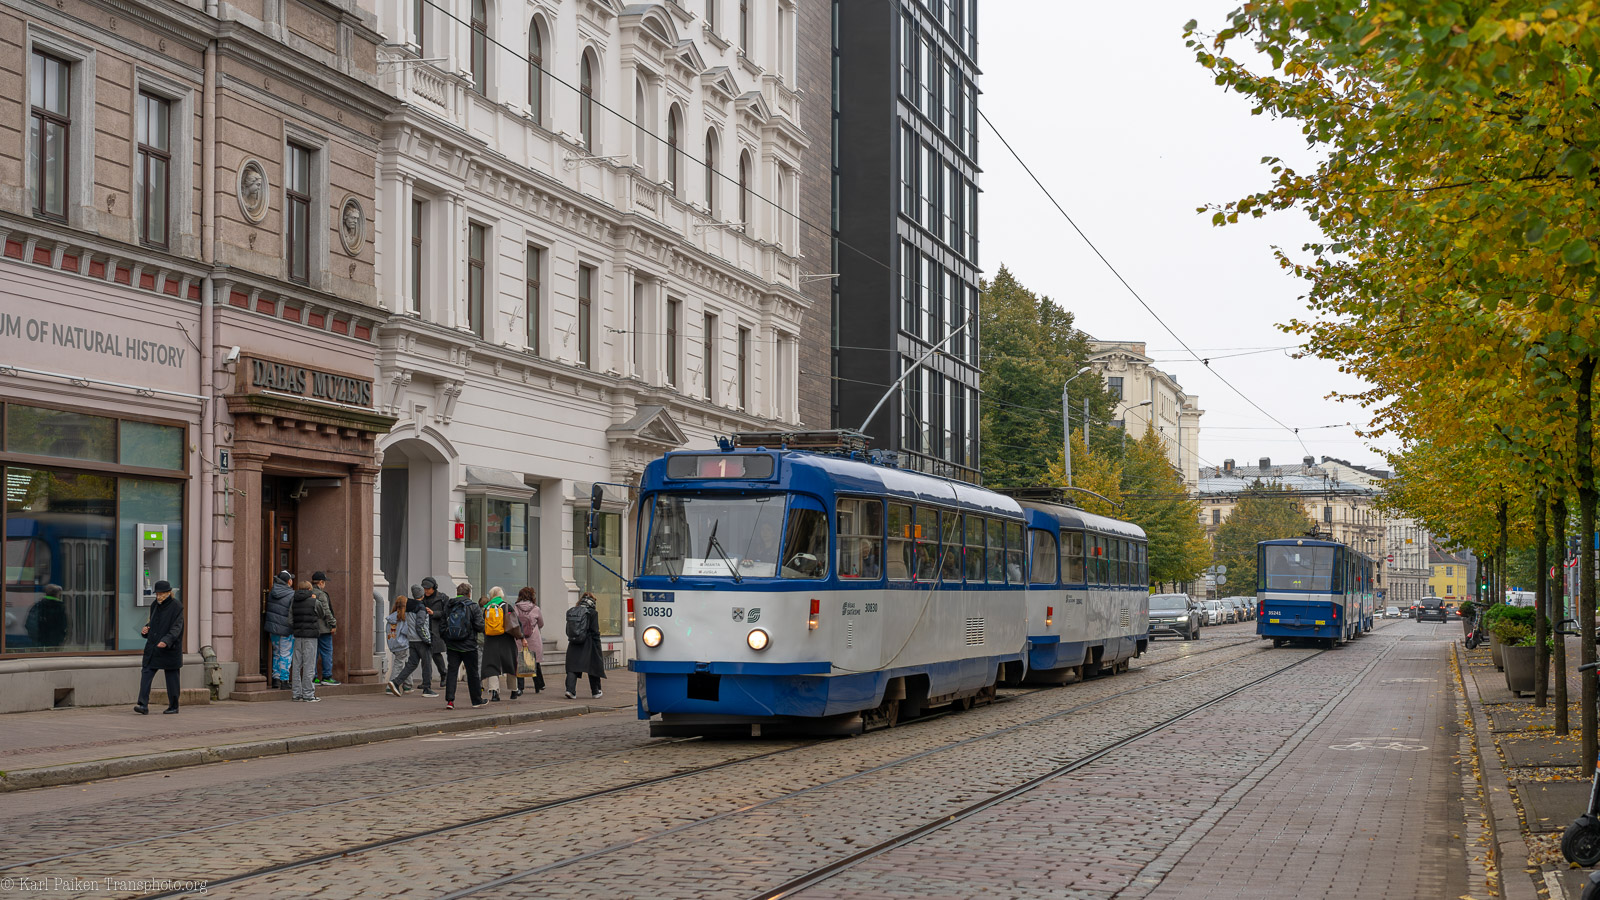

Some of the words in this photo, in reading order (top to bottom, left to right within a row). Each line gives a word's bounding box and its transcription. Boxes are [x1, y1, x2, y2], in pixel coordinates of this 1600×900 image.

[26, 319, 49, 343] OF
[52, 323, 122, 357] NATURAL
[126, 337, 185, 368] HISTORY
[253, 359, 307, 394] DABAS
[312, 371, 371, 406] MUZEJS
[718, 458, 726, 477] 1
[643, 606, 673, 618] 30830
[865, 603, 878, 613] 30830
